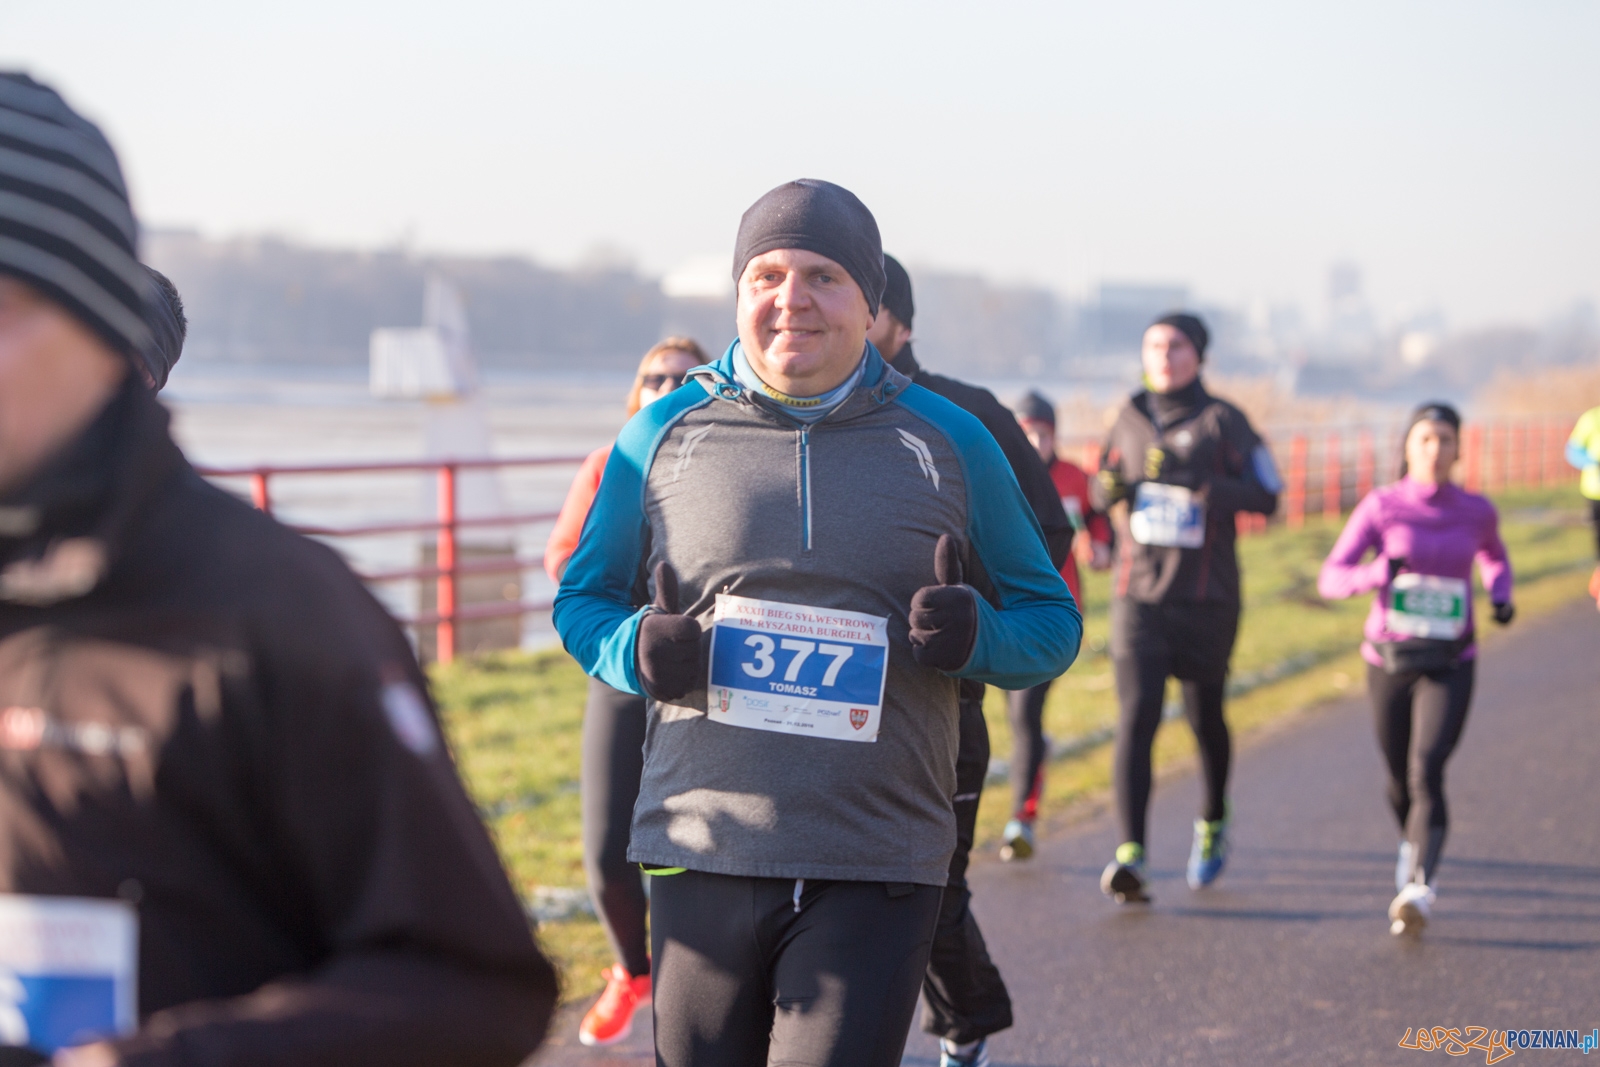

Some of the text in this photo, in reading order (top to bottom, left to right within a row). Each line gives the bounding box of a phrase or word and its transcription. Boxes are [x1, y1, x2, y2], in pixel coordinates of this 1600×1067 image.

[736, 605, 765, 617] XXXII
[767, 609, 793, 620] BIEG
[795, 613, 877, 631] SYLWESTROWY
[739, 617, 872, 642] IM. RYSZARDA BURGIELA
[741, 634, 854, 687] 377
[768, 682, 818, 697] TOMASZ
